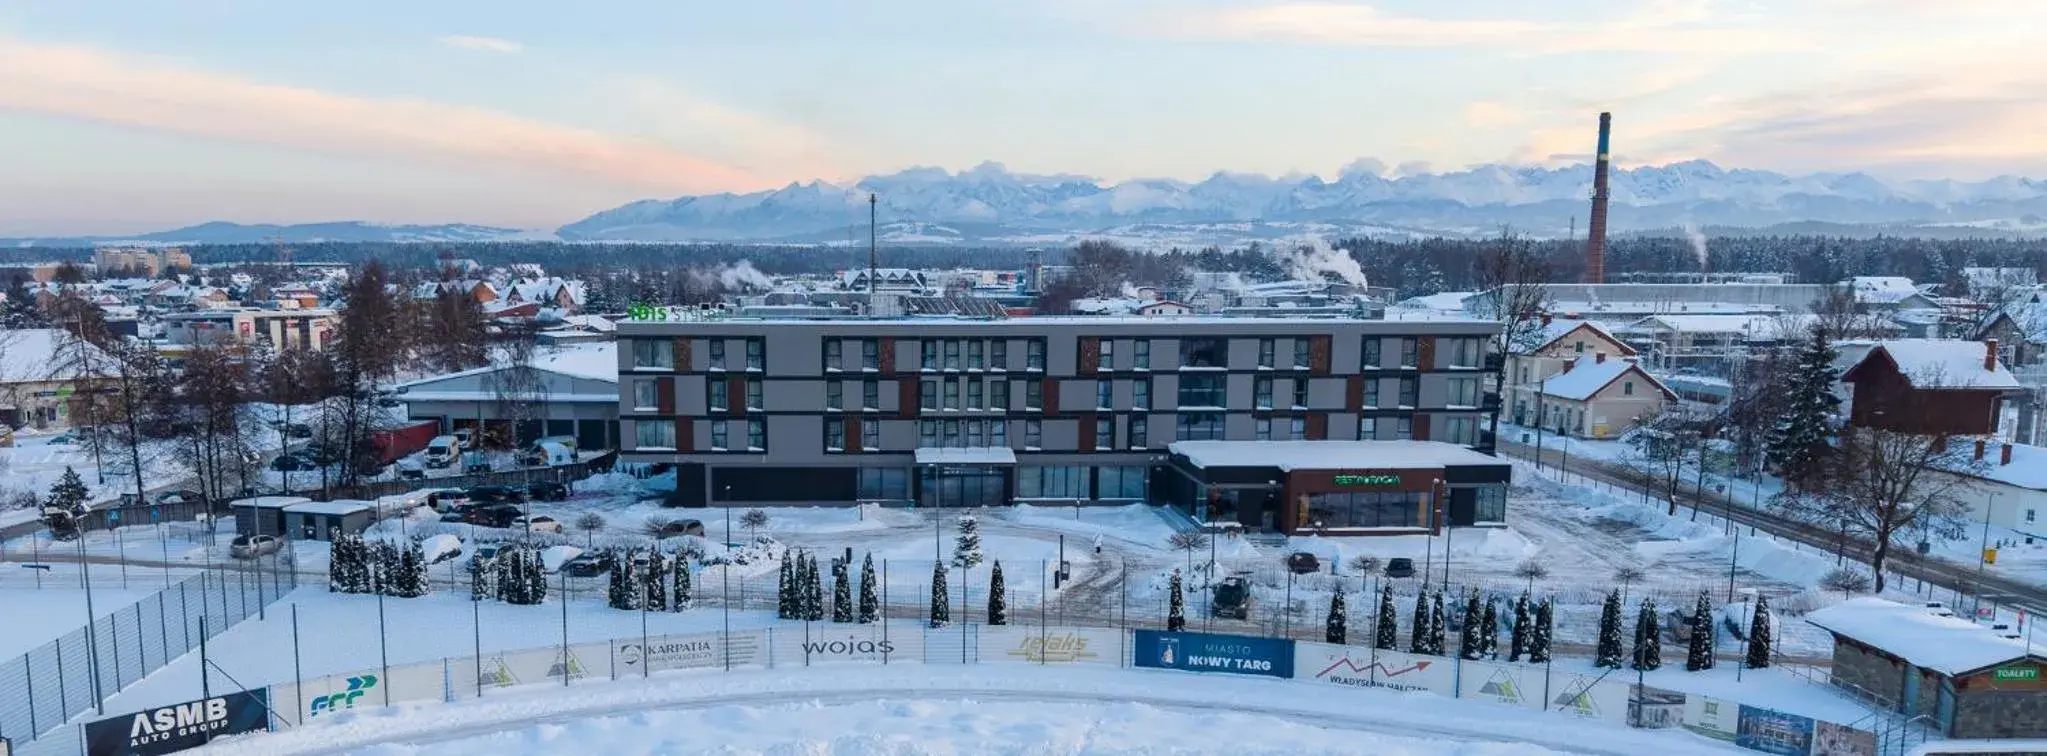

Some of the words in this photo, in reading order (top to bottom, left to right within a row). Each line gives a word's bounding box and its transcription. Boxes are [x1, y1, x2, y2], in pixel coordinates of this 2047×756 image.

[648, 640, 711, 656] KARPATIA
[1205, 644, 1250, 655] MIASTO
[1188, 655, 1231, 669] NOWY
[1235, 658, 1272, 671] TARG
[130, 697, 228, 738] ASMB
[131, 732, 170, 747] AUTO
[179, 719, 229, 737] GROUP
